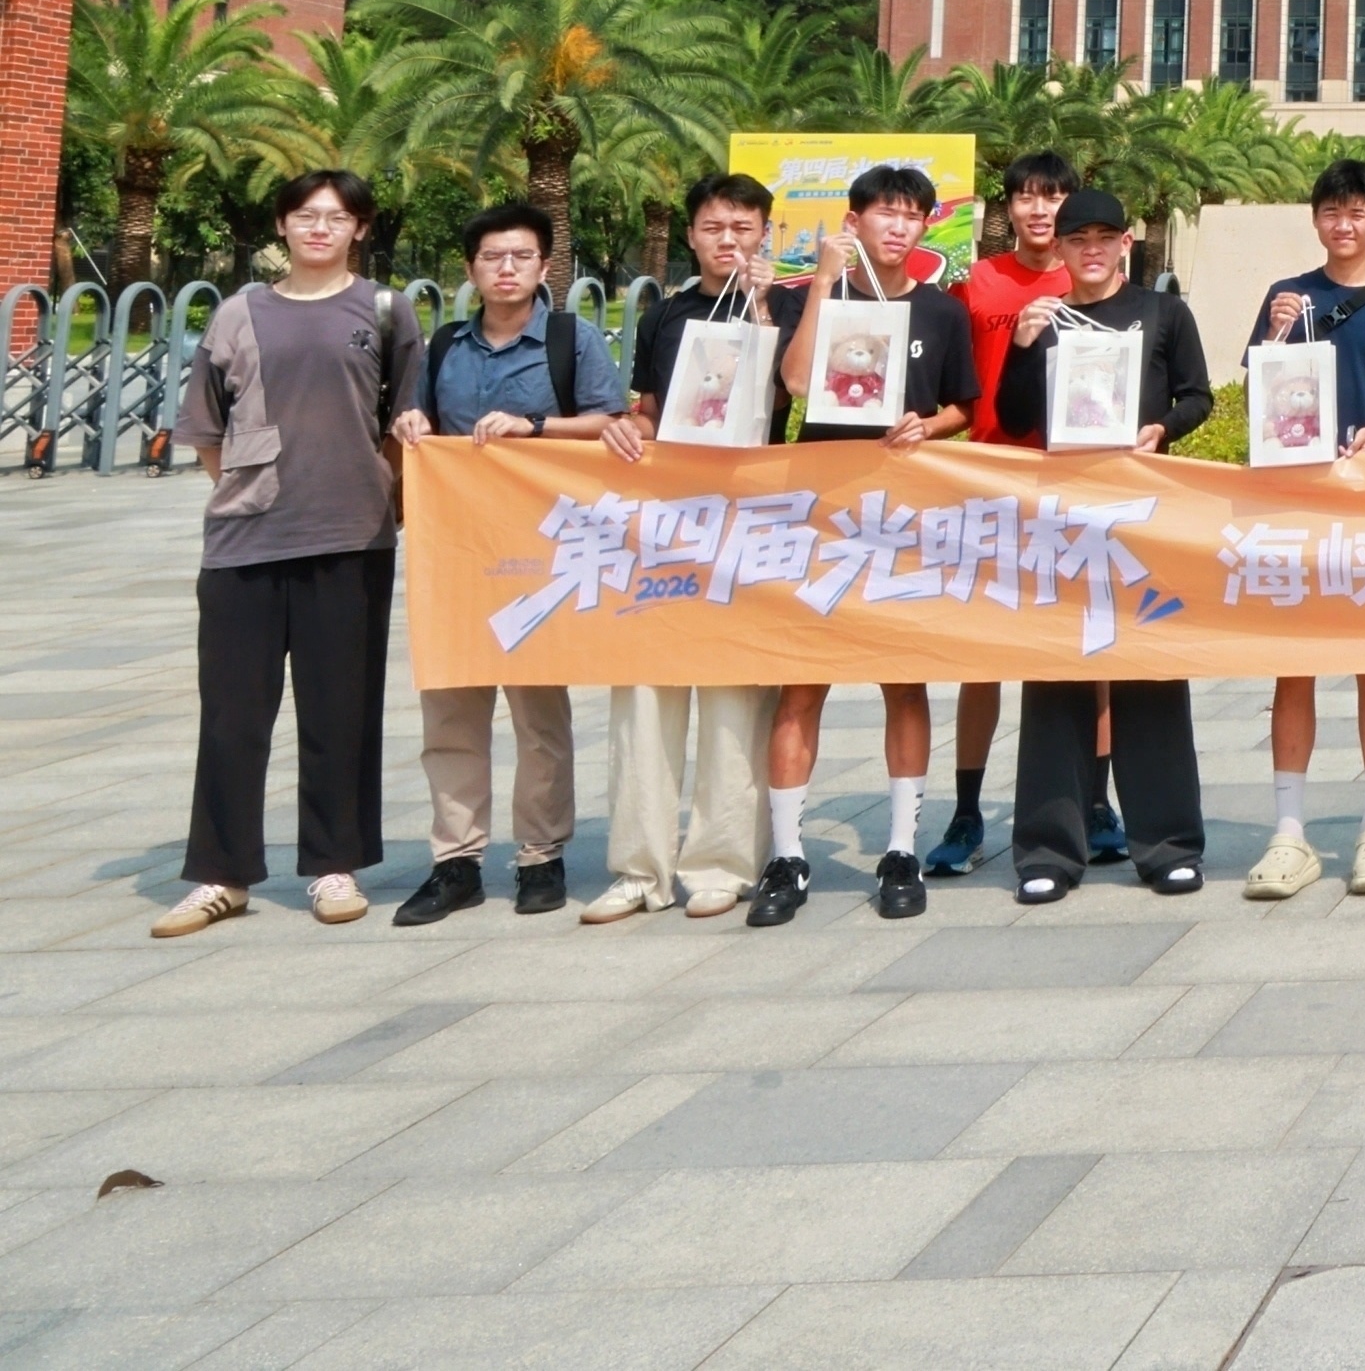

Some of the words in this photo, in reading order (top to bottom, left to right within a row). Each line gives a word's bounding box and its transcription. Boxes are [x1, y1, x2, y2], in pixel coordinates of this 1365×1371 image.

[488, 489, 1159, 654] 第四届光明杯
[635, 572, 700, 602] 2026
